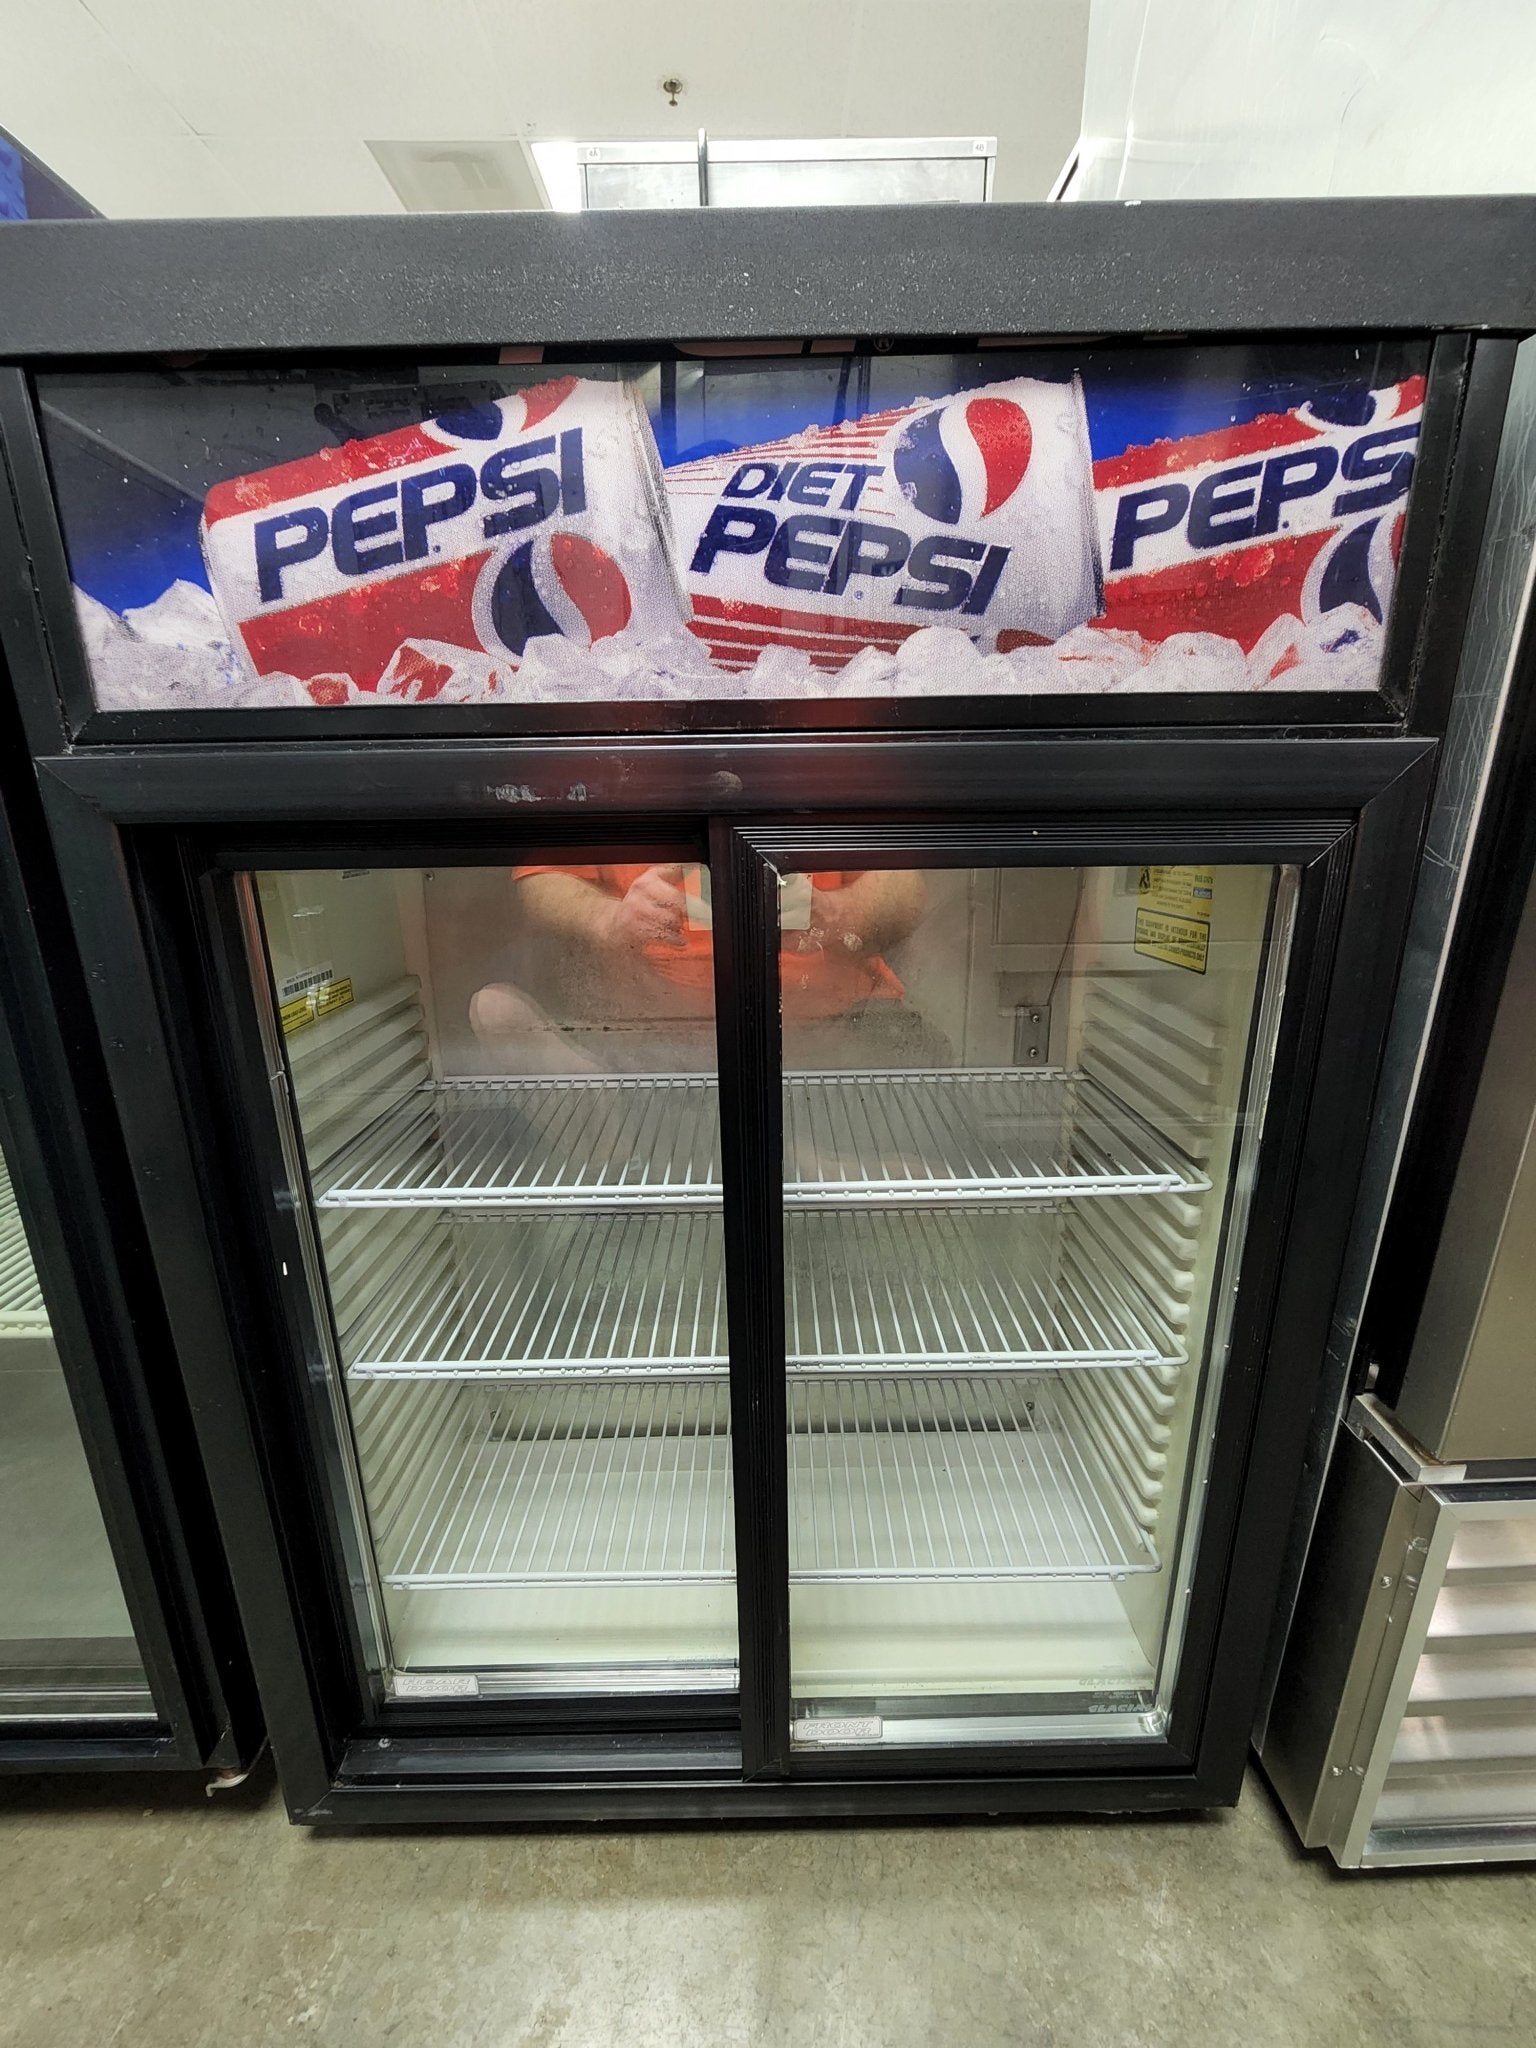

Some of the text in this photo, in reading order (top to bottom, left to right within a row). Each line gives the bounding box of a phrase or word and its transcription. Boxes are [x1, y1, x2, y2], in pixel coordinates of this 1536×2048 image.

[252, 427, 588, 603] PEPSI
[721, 461, 887, 511] DIET
[689, 503, 1013, 616] PEPSI
